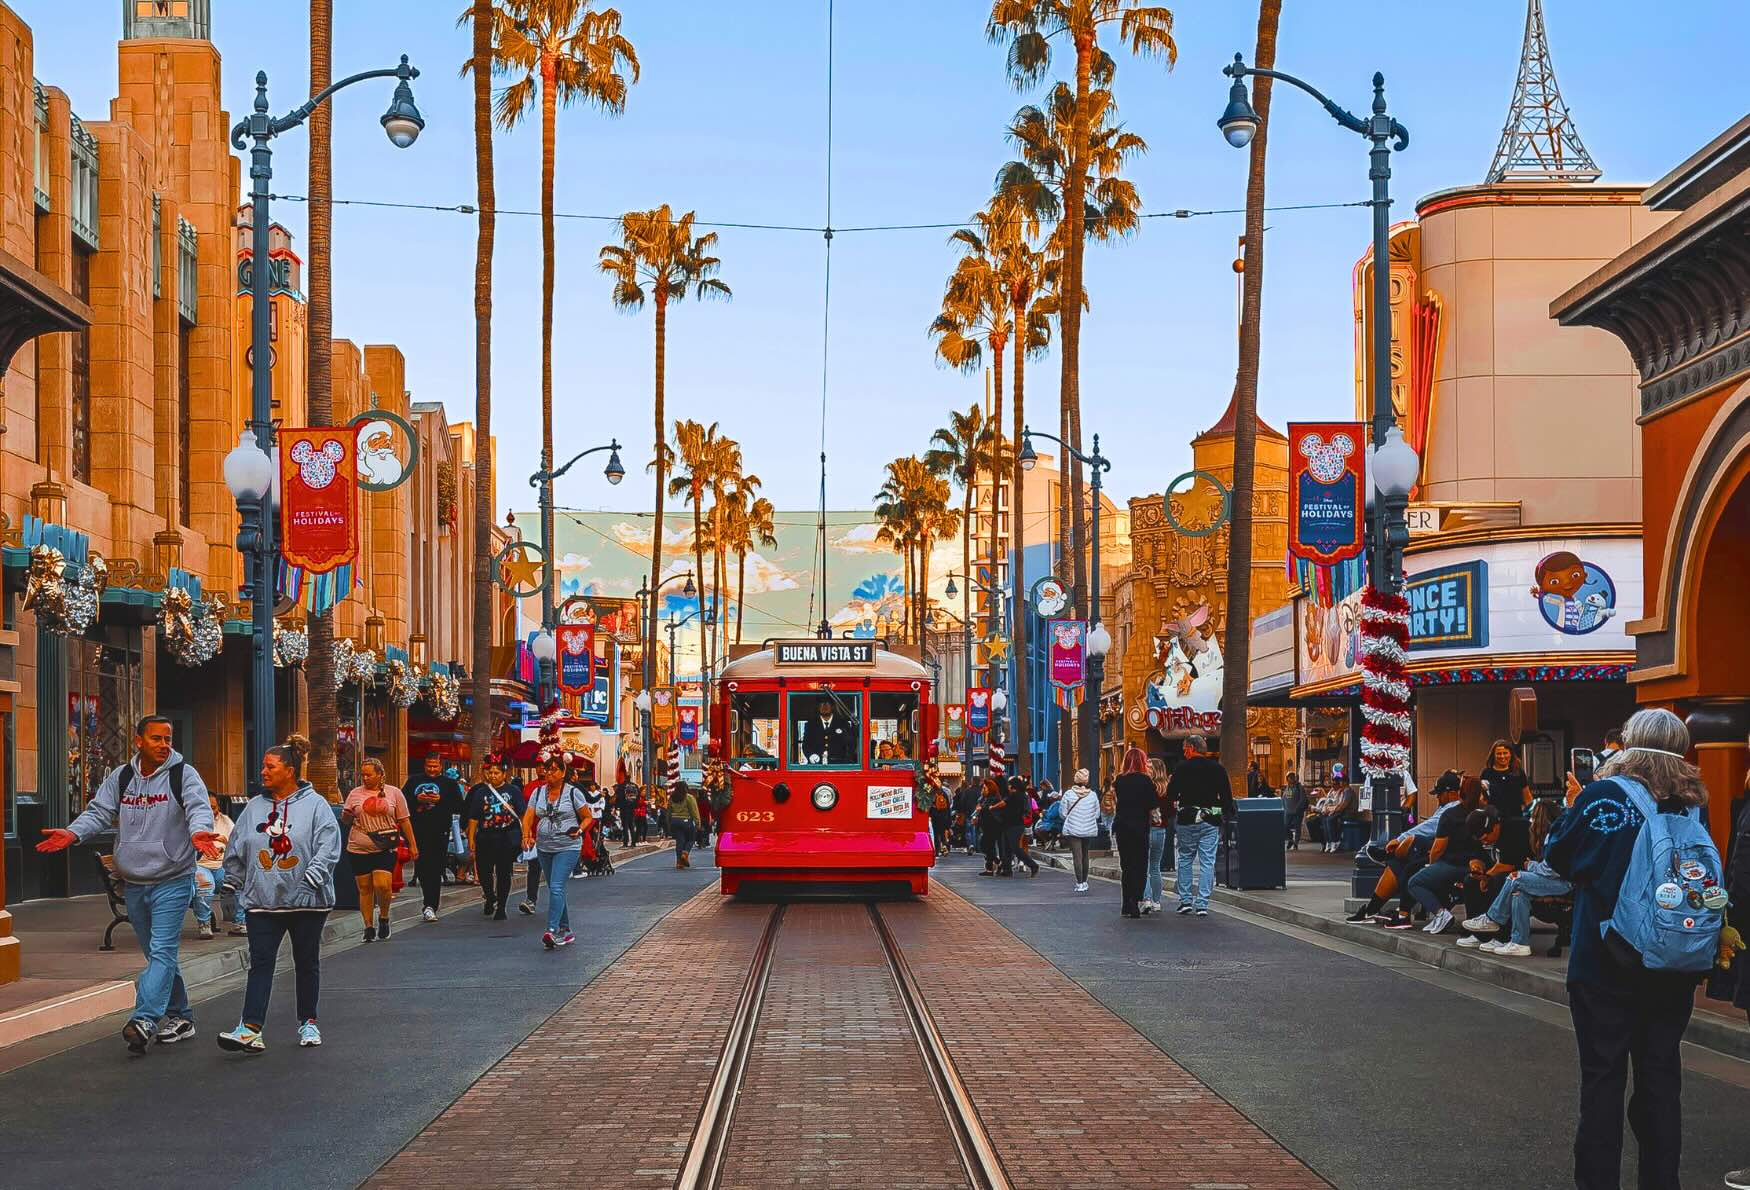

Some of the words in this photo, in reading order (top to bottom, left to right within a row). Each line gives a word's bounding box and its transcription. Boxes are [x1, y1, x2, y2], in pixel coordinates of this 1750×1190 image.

[237, 258, 290, 288] GNE
[1301, 510, 1353, 518] HOLIDAYS
[293, 517, 344, 525] HOLIDAYS
[782, 646, 818, 661] BUENA
[820, 646, 851, 661] VISTA
[853, 646, 868, 661] ST
[736, 811, 775, 822] 623
